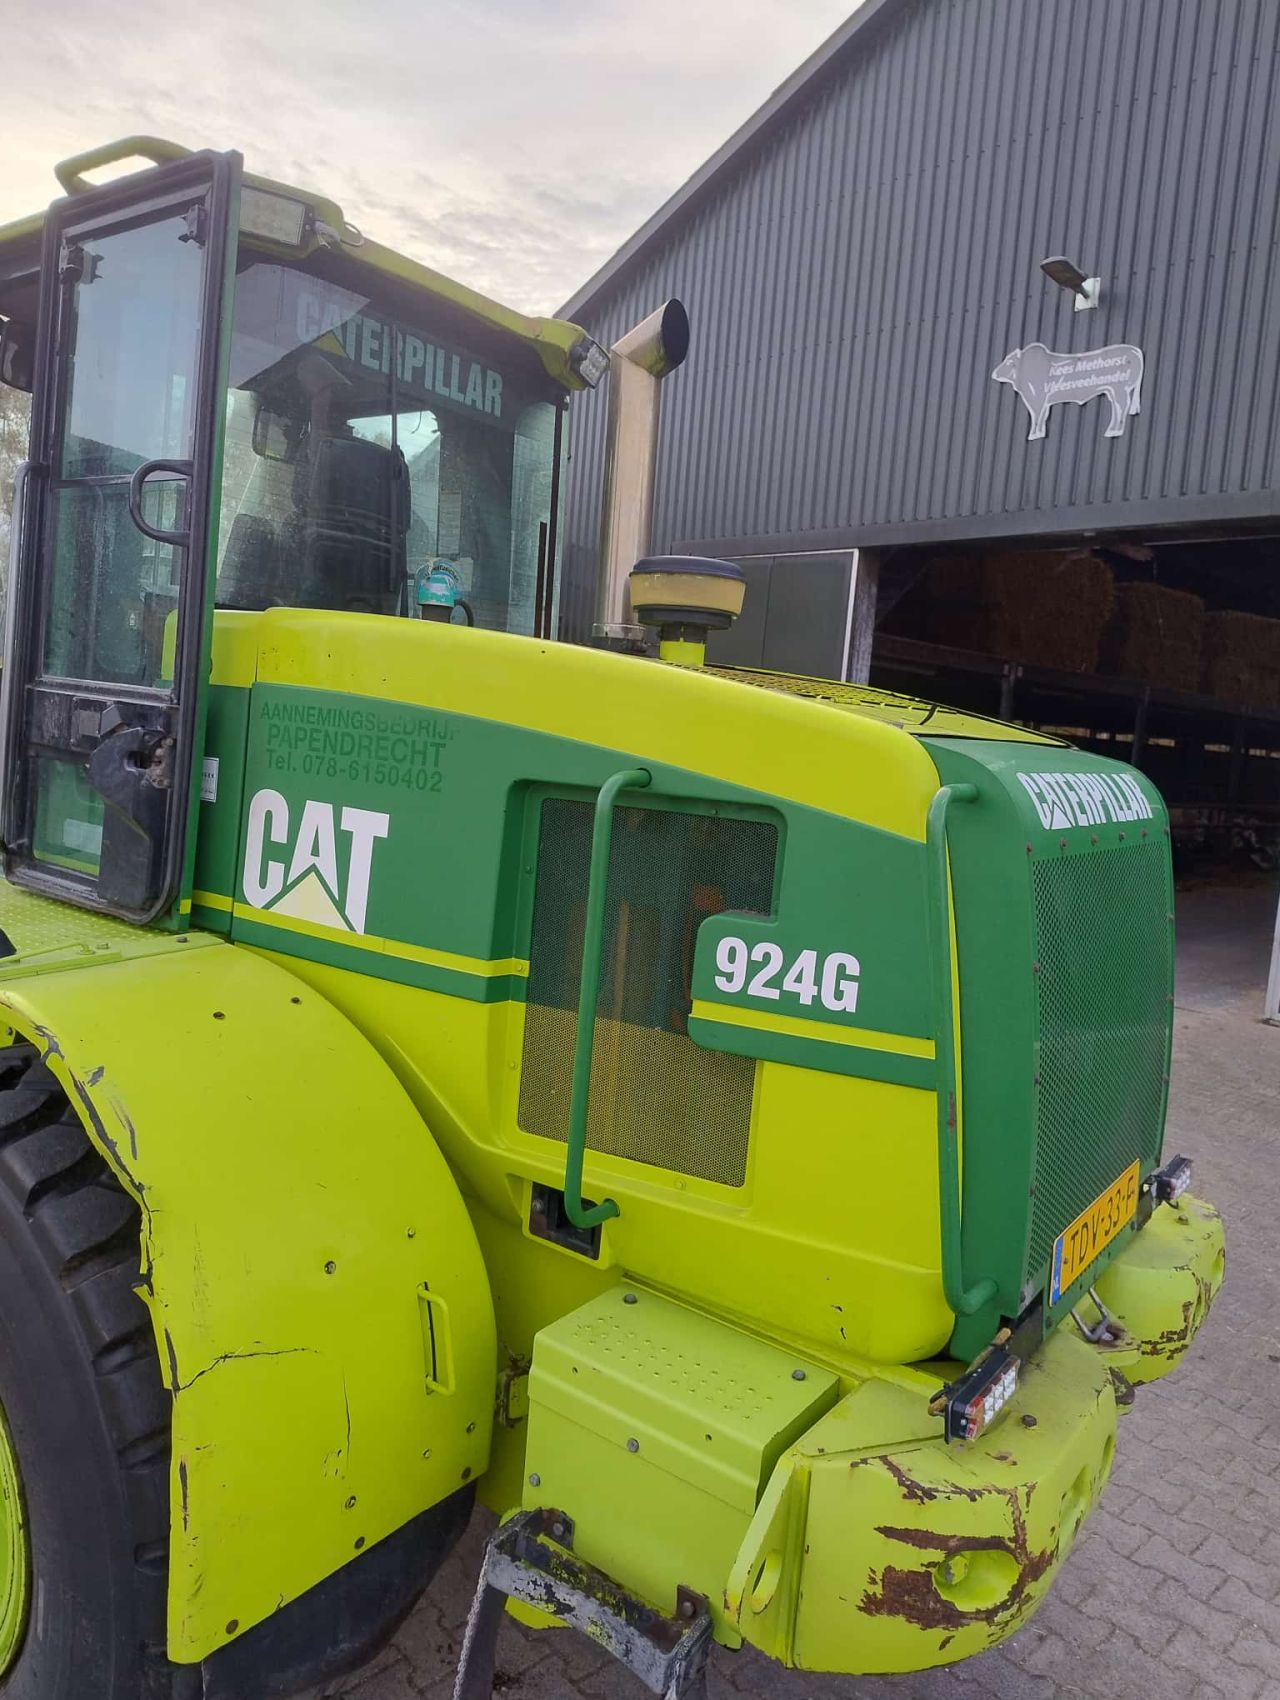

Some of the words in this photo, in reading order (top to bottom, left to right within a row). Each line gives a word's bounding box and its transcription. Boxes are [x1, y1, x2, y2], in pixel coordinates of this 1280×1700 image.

[297, 292, 503, 417] CATERPILLAR
[1075, 355, 1127, 372] Methorst
[266, 749, 297, 773] Tel.
[303, 753, 443, 792] 078-6150402
[267, 724, 447, 768] PAPENDRECHT
[1016, 772, 1153, 830] CATERPILLAR
[243, 788, 390, 935] CAT
[714, 936, 860, 1013] 924G
[1070, 1175, 1134, 1273] TDV-33-F
